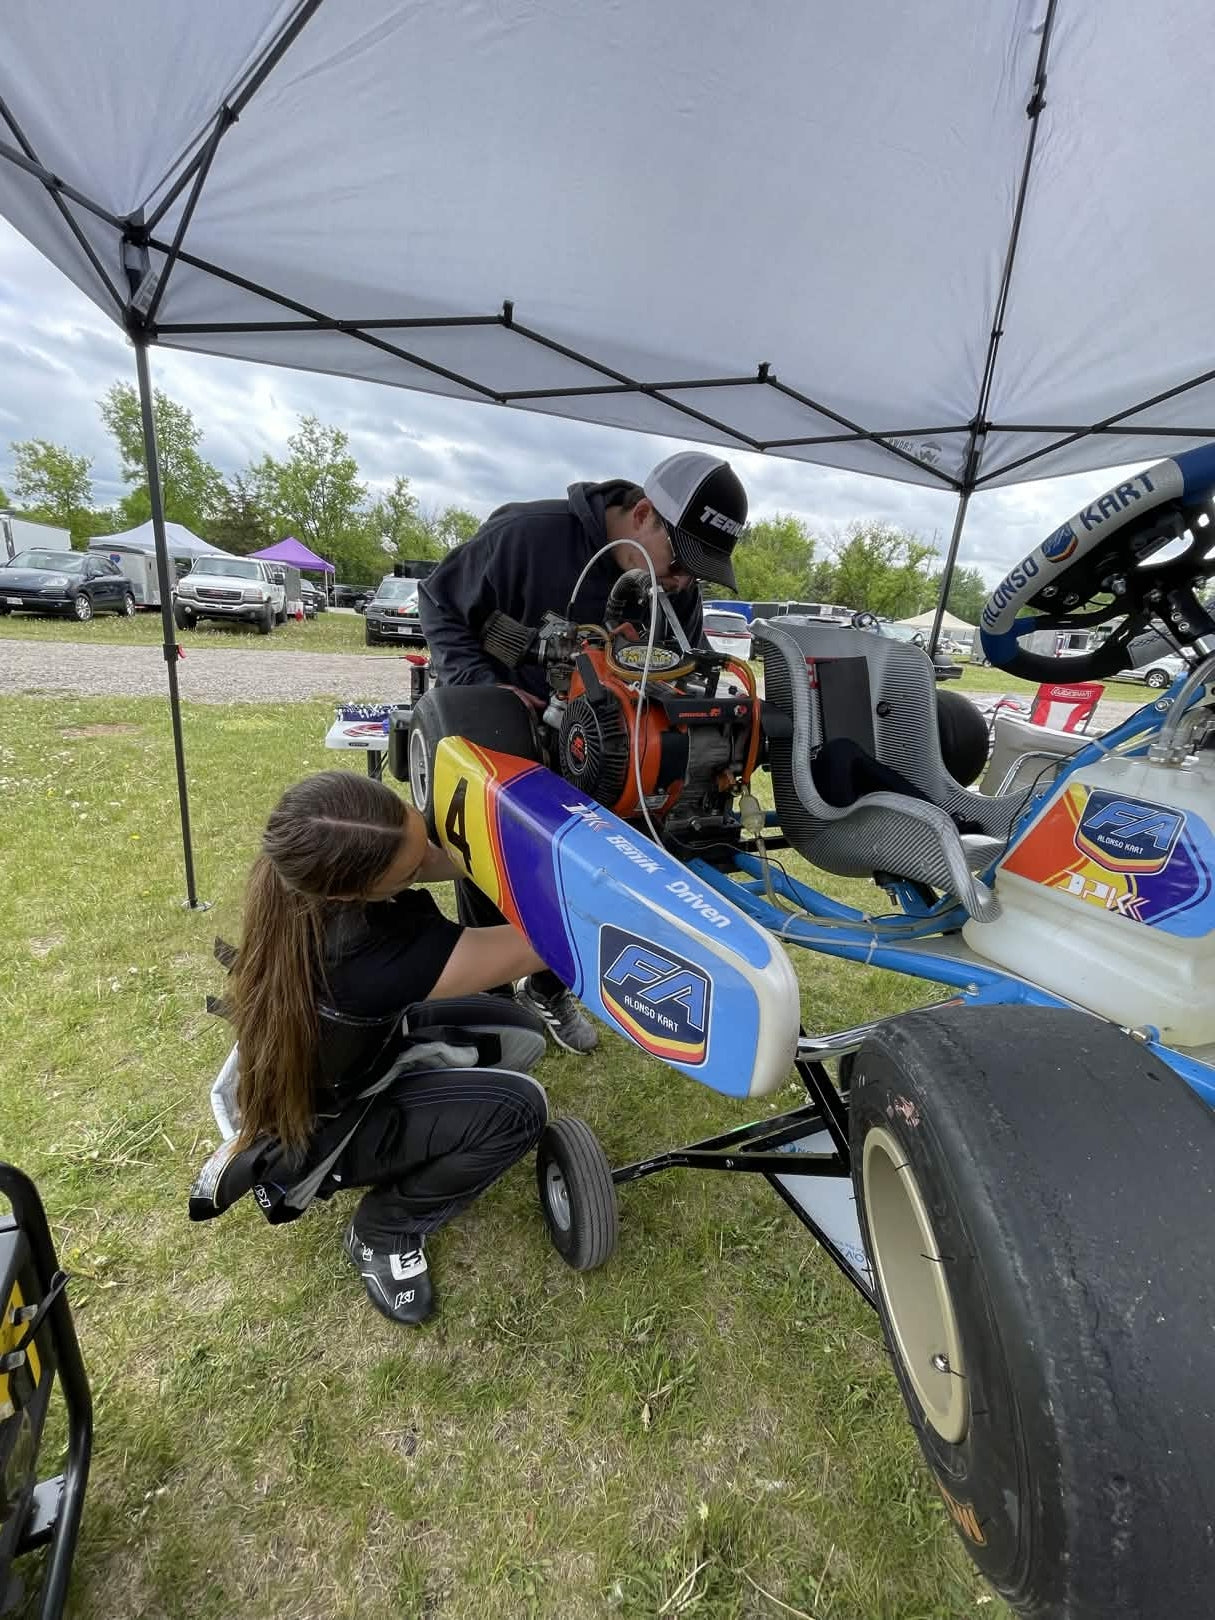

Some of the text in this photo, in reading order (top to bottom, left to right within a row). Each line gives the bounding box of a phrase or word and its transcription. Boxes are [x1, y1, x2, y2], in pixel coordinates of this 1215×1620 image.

[982, 471, 1155, 627] ALONSO KART
[445, 776, 474, 877] 4
[1097, 834, 1144, 855] ALONSO KART
[665, 880, 732, 929] Driven
[603, 944, 708, 1033] FA
[624, 995, 679, 1033] ALONSO KART
